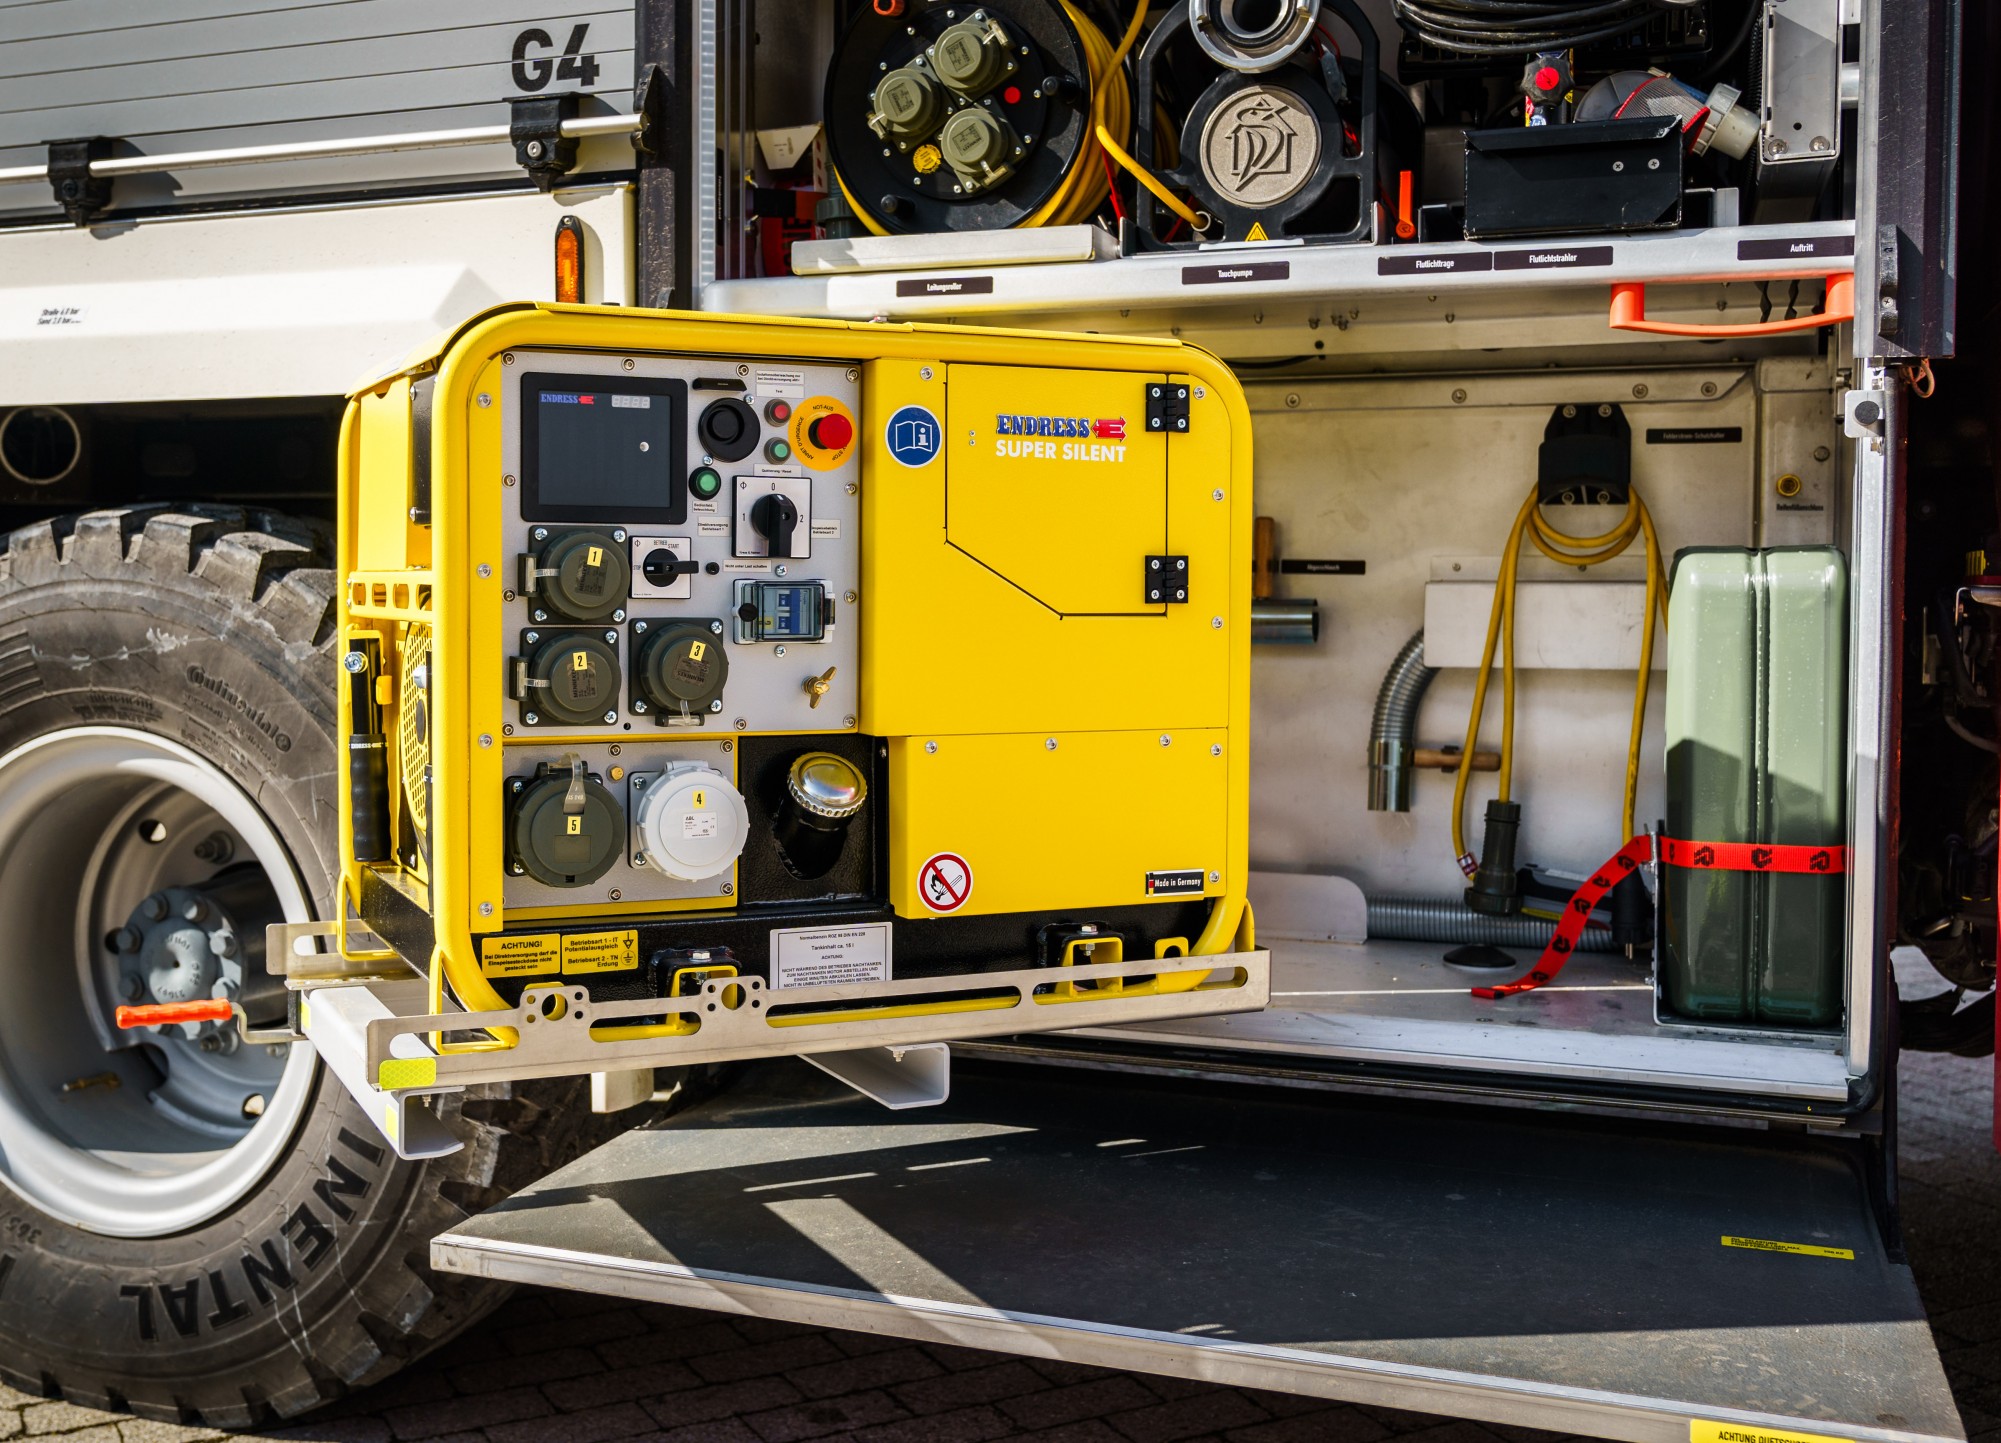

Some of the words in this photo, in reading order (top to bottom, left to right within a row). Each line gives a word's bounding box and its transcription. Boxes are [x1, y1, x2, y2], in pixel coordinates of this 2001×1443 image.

[511, 23, 600, 92] G4
[1789, 243, 1814, 253] Auftritt
[1529, 253, 1578, 264] Flutlichtstrahler
[1217, 269, 1253, 279] Tauchpumpe
[540, 393, 579, 405] ENDRESS
[812, 404, 834, 412] NOT-AUS
[996, 414, 1090, 438] ENDRESS
[996, 439, 1057, 460] SUPER
[1062, 443, 1127, 463] SILENT
[771, 482, 776, 491] 0
[742, 513, 746, 522] 1
[799, 514, 804, 522] 2
[592, 550, 597, 559] 1
[693, 645, 702, 657] 3
[577, 655, 583, 668] 2
[186, 664, 280, 741] Continental
[696, 793, 702, 805] 4
[571, 819, 577, 832] 5
[1154, 878, 1169, 887] Made
[1177, 877, 1202, 887] Germany
[500, 940, 543, 950] ACHTUNG!
[570, 938, 603, 946] Betriebsart
[811, 943, 837, 951] Tankinhalt
[564, 943, 619, 952] Potentialausgleich
[494, 951, 538, 960] Direktversorgung
[567, 956, 601, 964] Betriebsart
[504, 964, 527, 972] gesteckt
[1718, 1430, 1756, 1443] ACHTUNG
